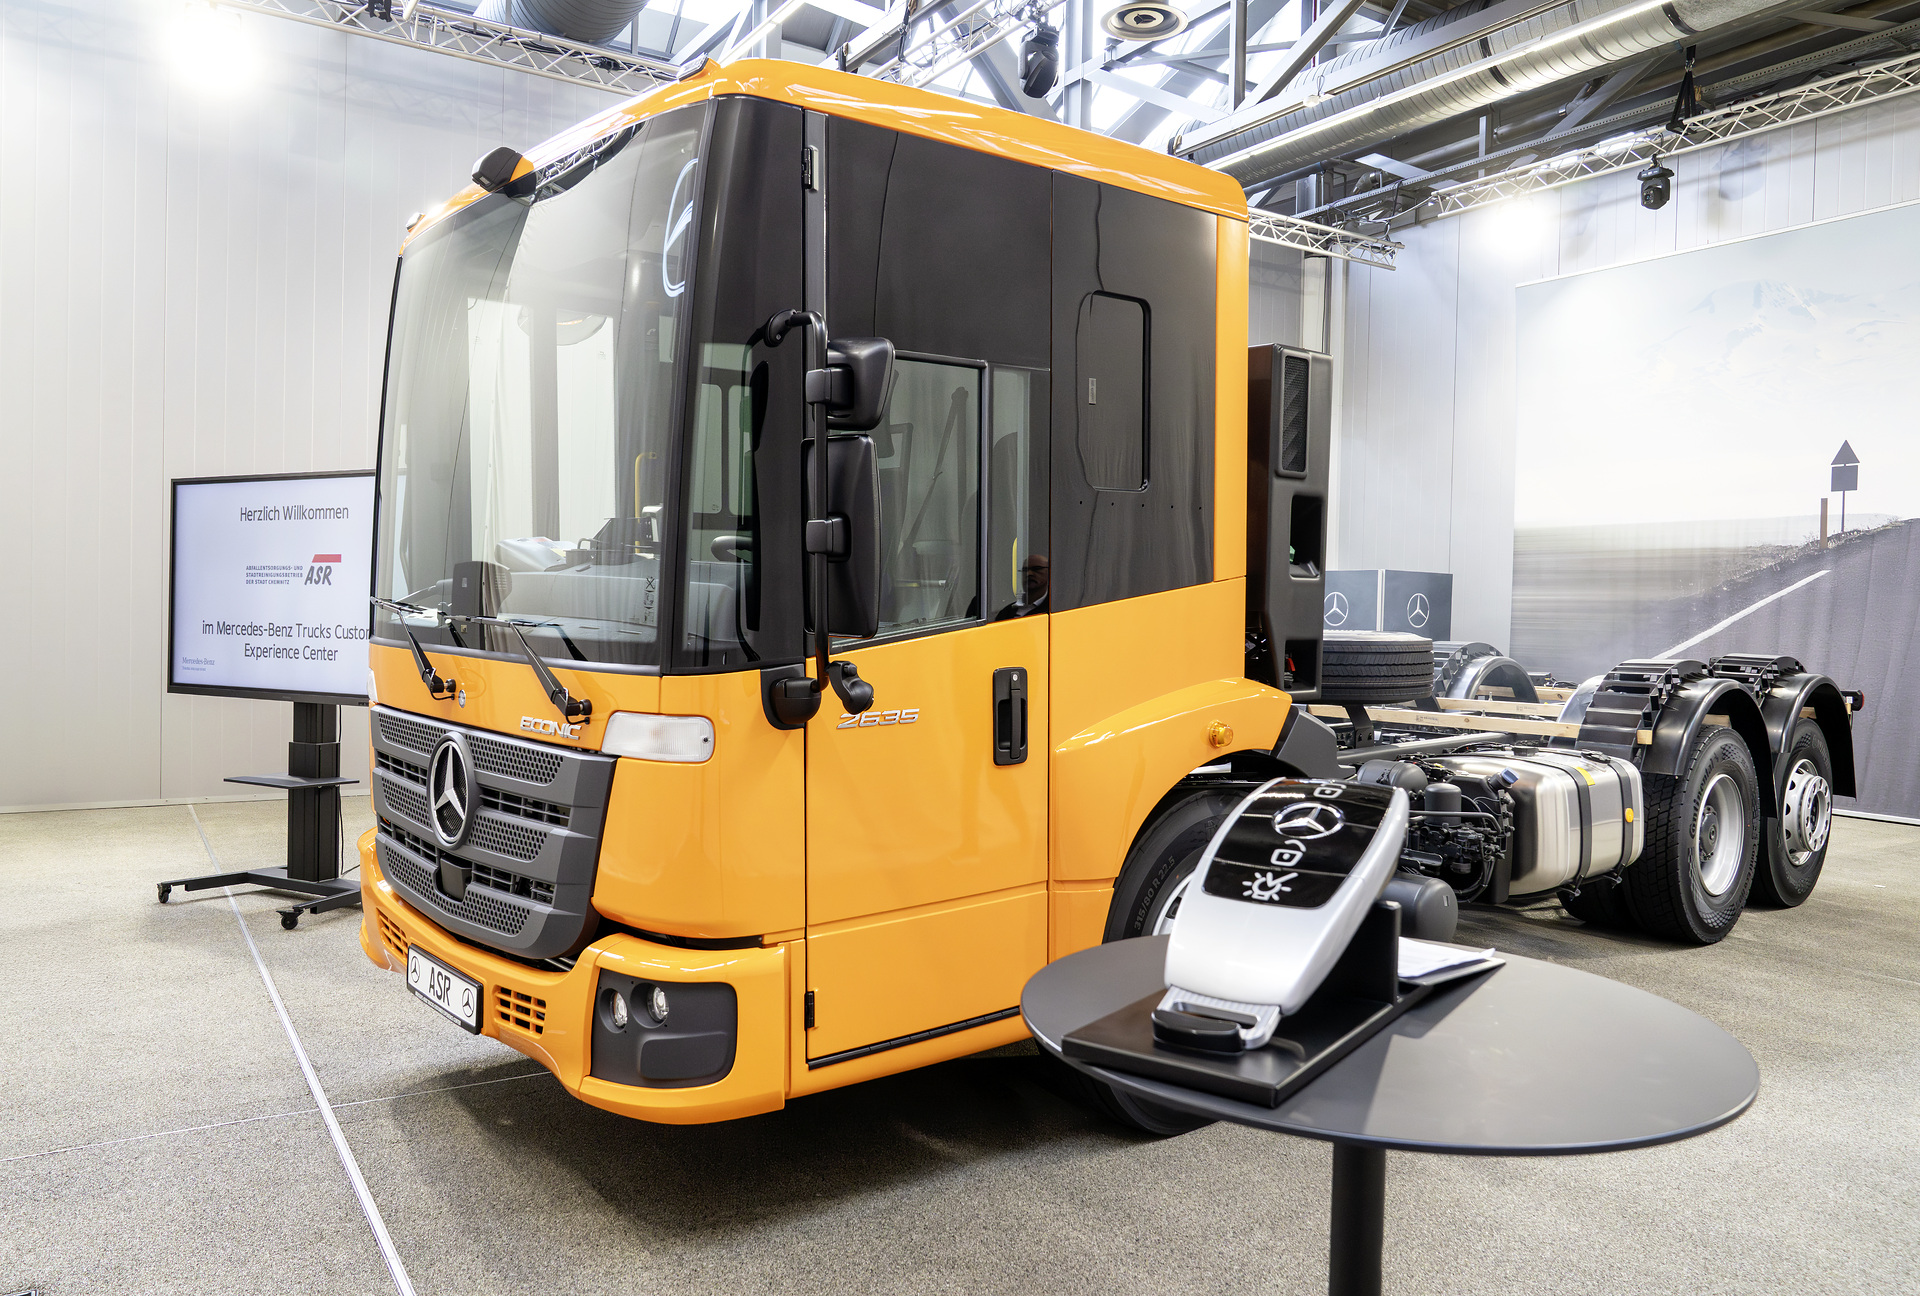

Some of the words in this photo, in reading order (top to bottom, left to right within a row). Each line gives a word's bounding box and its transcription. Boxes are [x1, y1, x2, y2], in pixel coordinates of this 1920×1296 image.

[240, 505, 280, 522] Herzlich
[282, 504, 349, 521] Willkommen
[304, 565, 332, 586] ASR
[202, 620, 214, 635] im
[216, 620, 293, 638] Mercedes-Benz
[296, 623, 332, 639] Trucks
[244, 643, 299, 661] Experience
[302, 645, 339, 662] Center
[520, 715, 582, 740] ECONIC
[836, 708, 920, 730] 2635
[1134, 887, 1155, 930] 315/80
[1152, 877, 1161, 889] R
[1158, 855, 1175, 880] 22.5
[428, 966, 451, 1007] ASR
